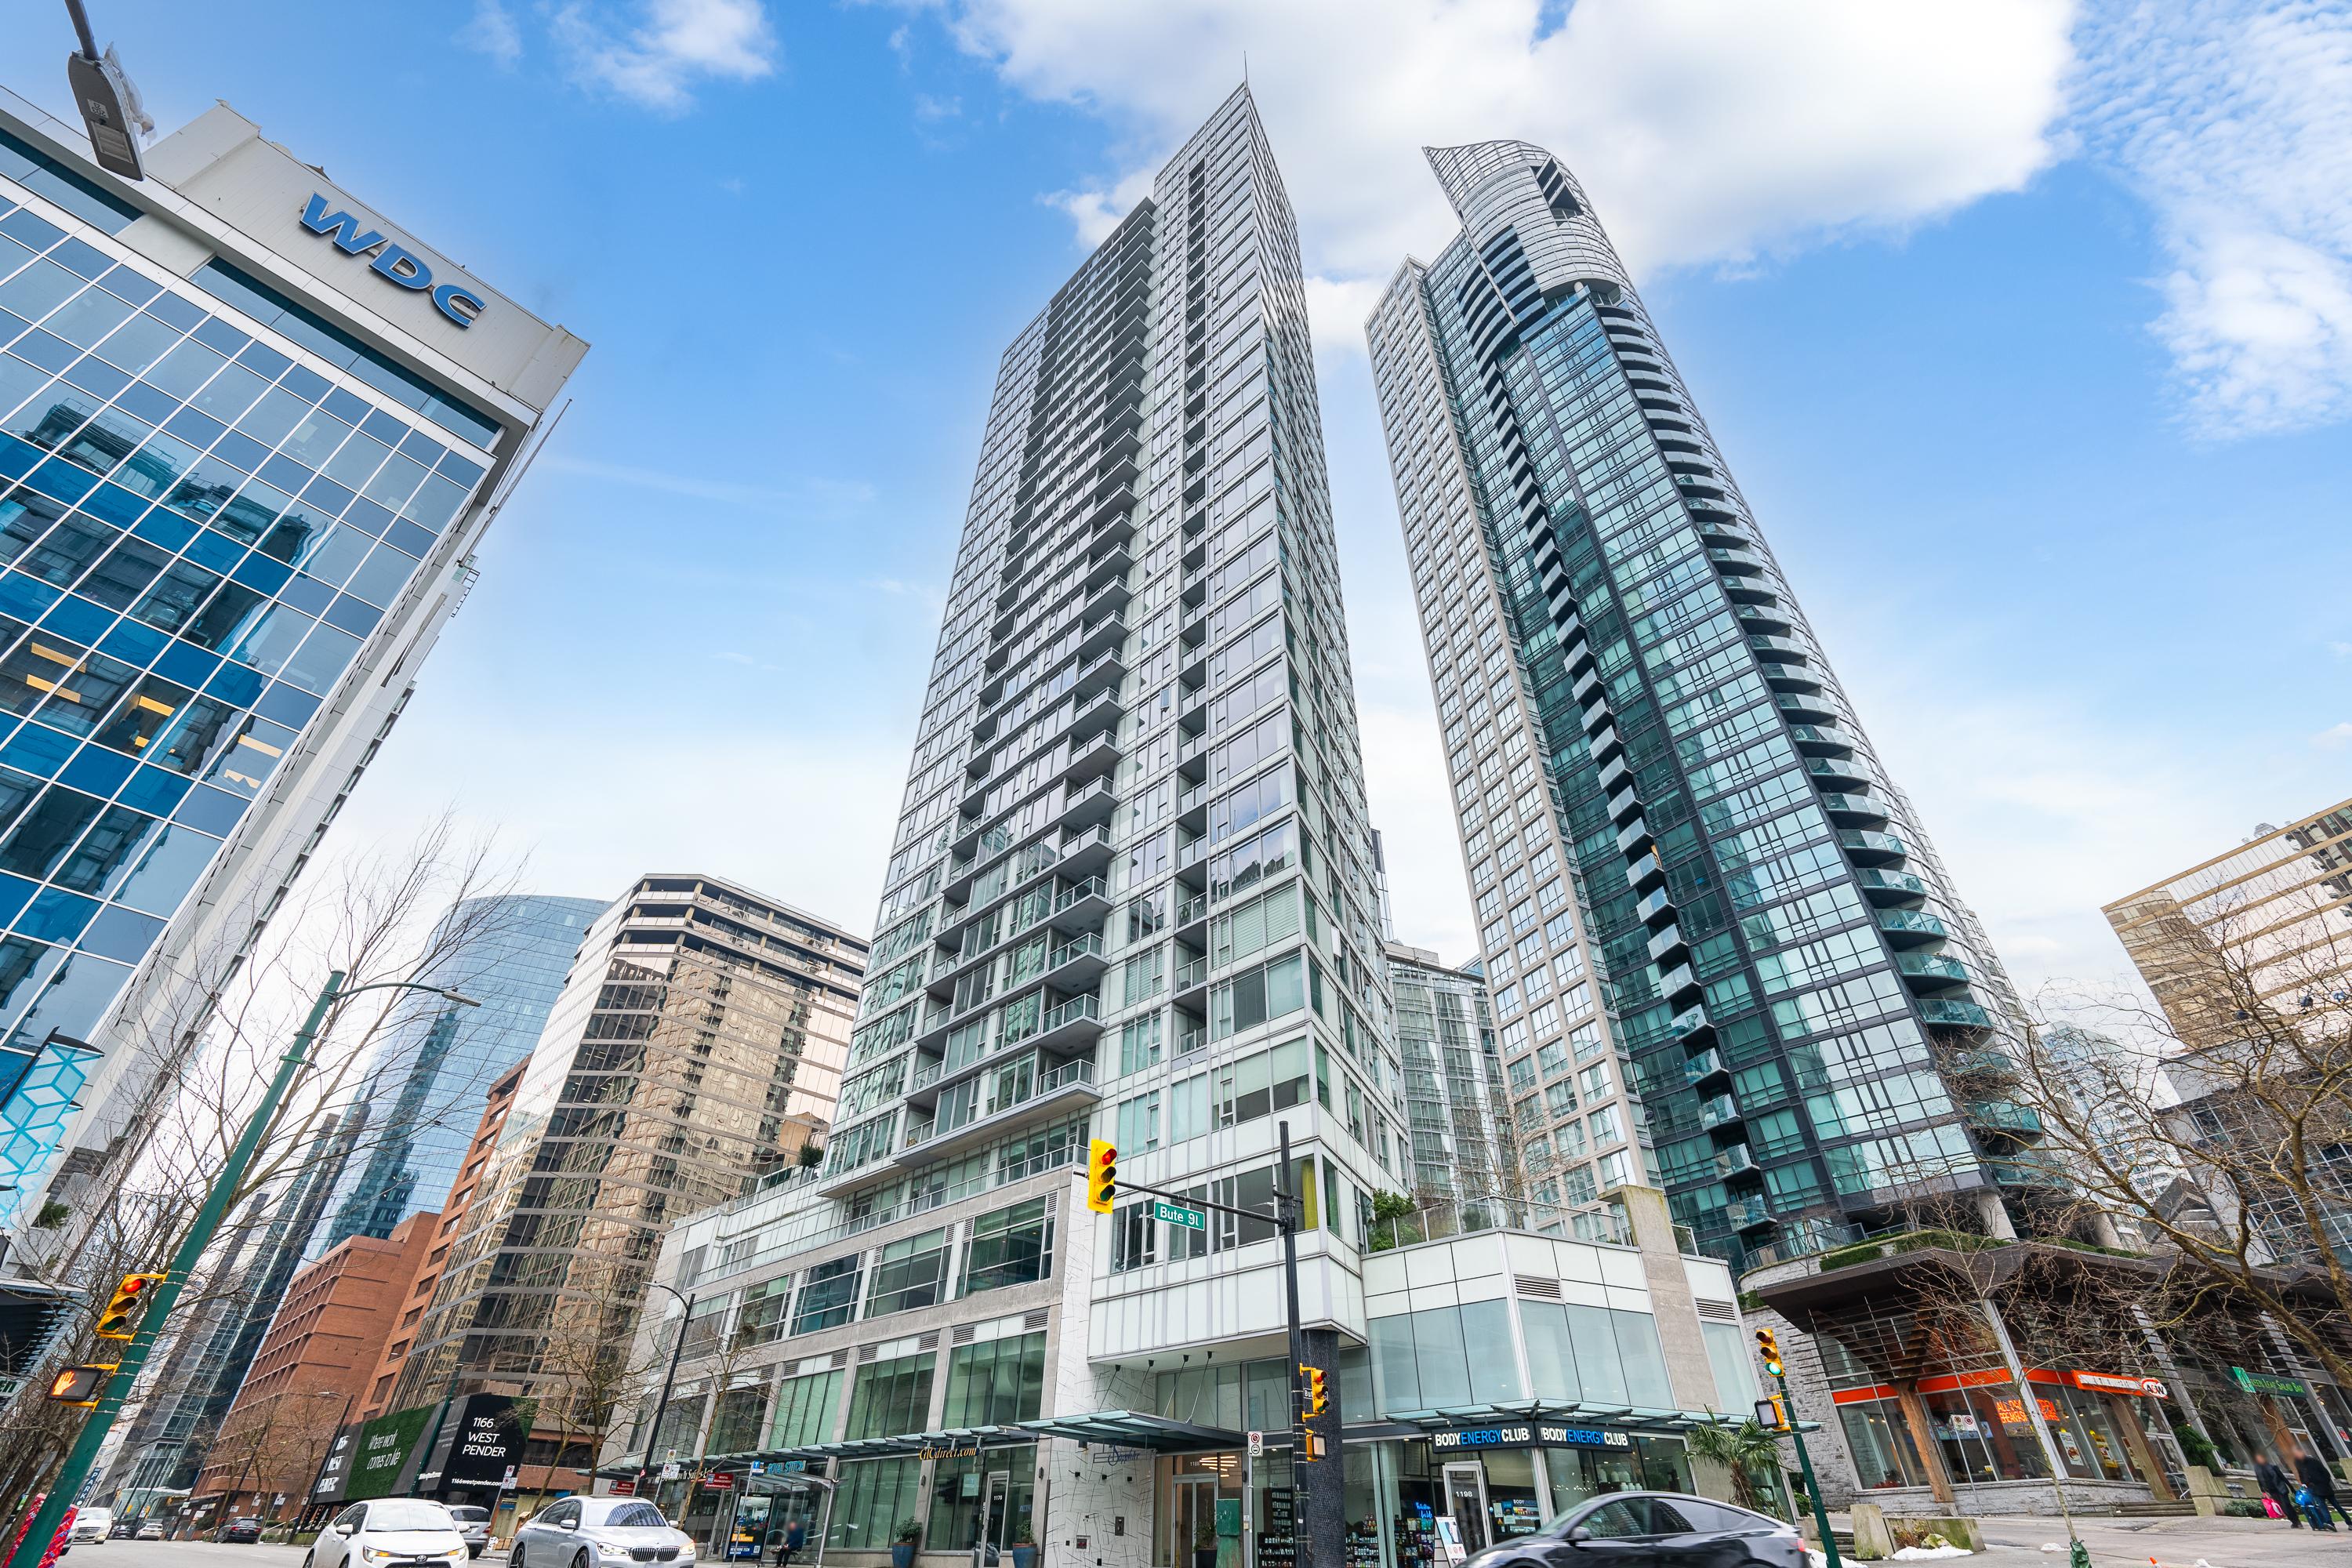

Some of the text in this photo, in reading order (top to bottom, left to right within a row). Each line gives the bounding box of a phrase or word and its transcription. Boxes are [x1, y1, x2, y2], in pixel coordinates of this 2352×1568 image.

[299, 192, 488, 328] WDC
[1160, 1206, 1184, 1221] Bute
[2146, 1383, 2165, 1395] A&W
[473, 1417, 495, 1428] 1166
[368, 1433, 384, 1450] Where
[468, 1432, 500, 1443] WEST
[1435, 1427, 1530, 1446] BODYENERGYCLUB
[1541, 1427, 1628, 1446] BODYENERGYCLUB
[462, 1444, 506, 1457] PENDER
[366, 1454, 387, 1470] comes
[80, 1472, 99, 1499] PARK
